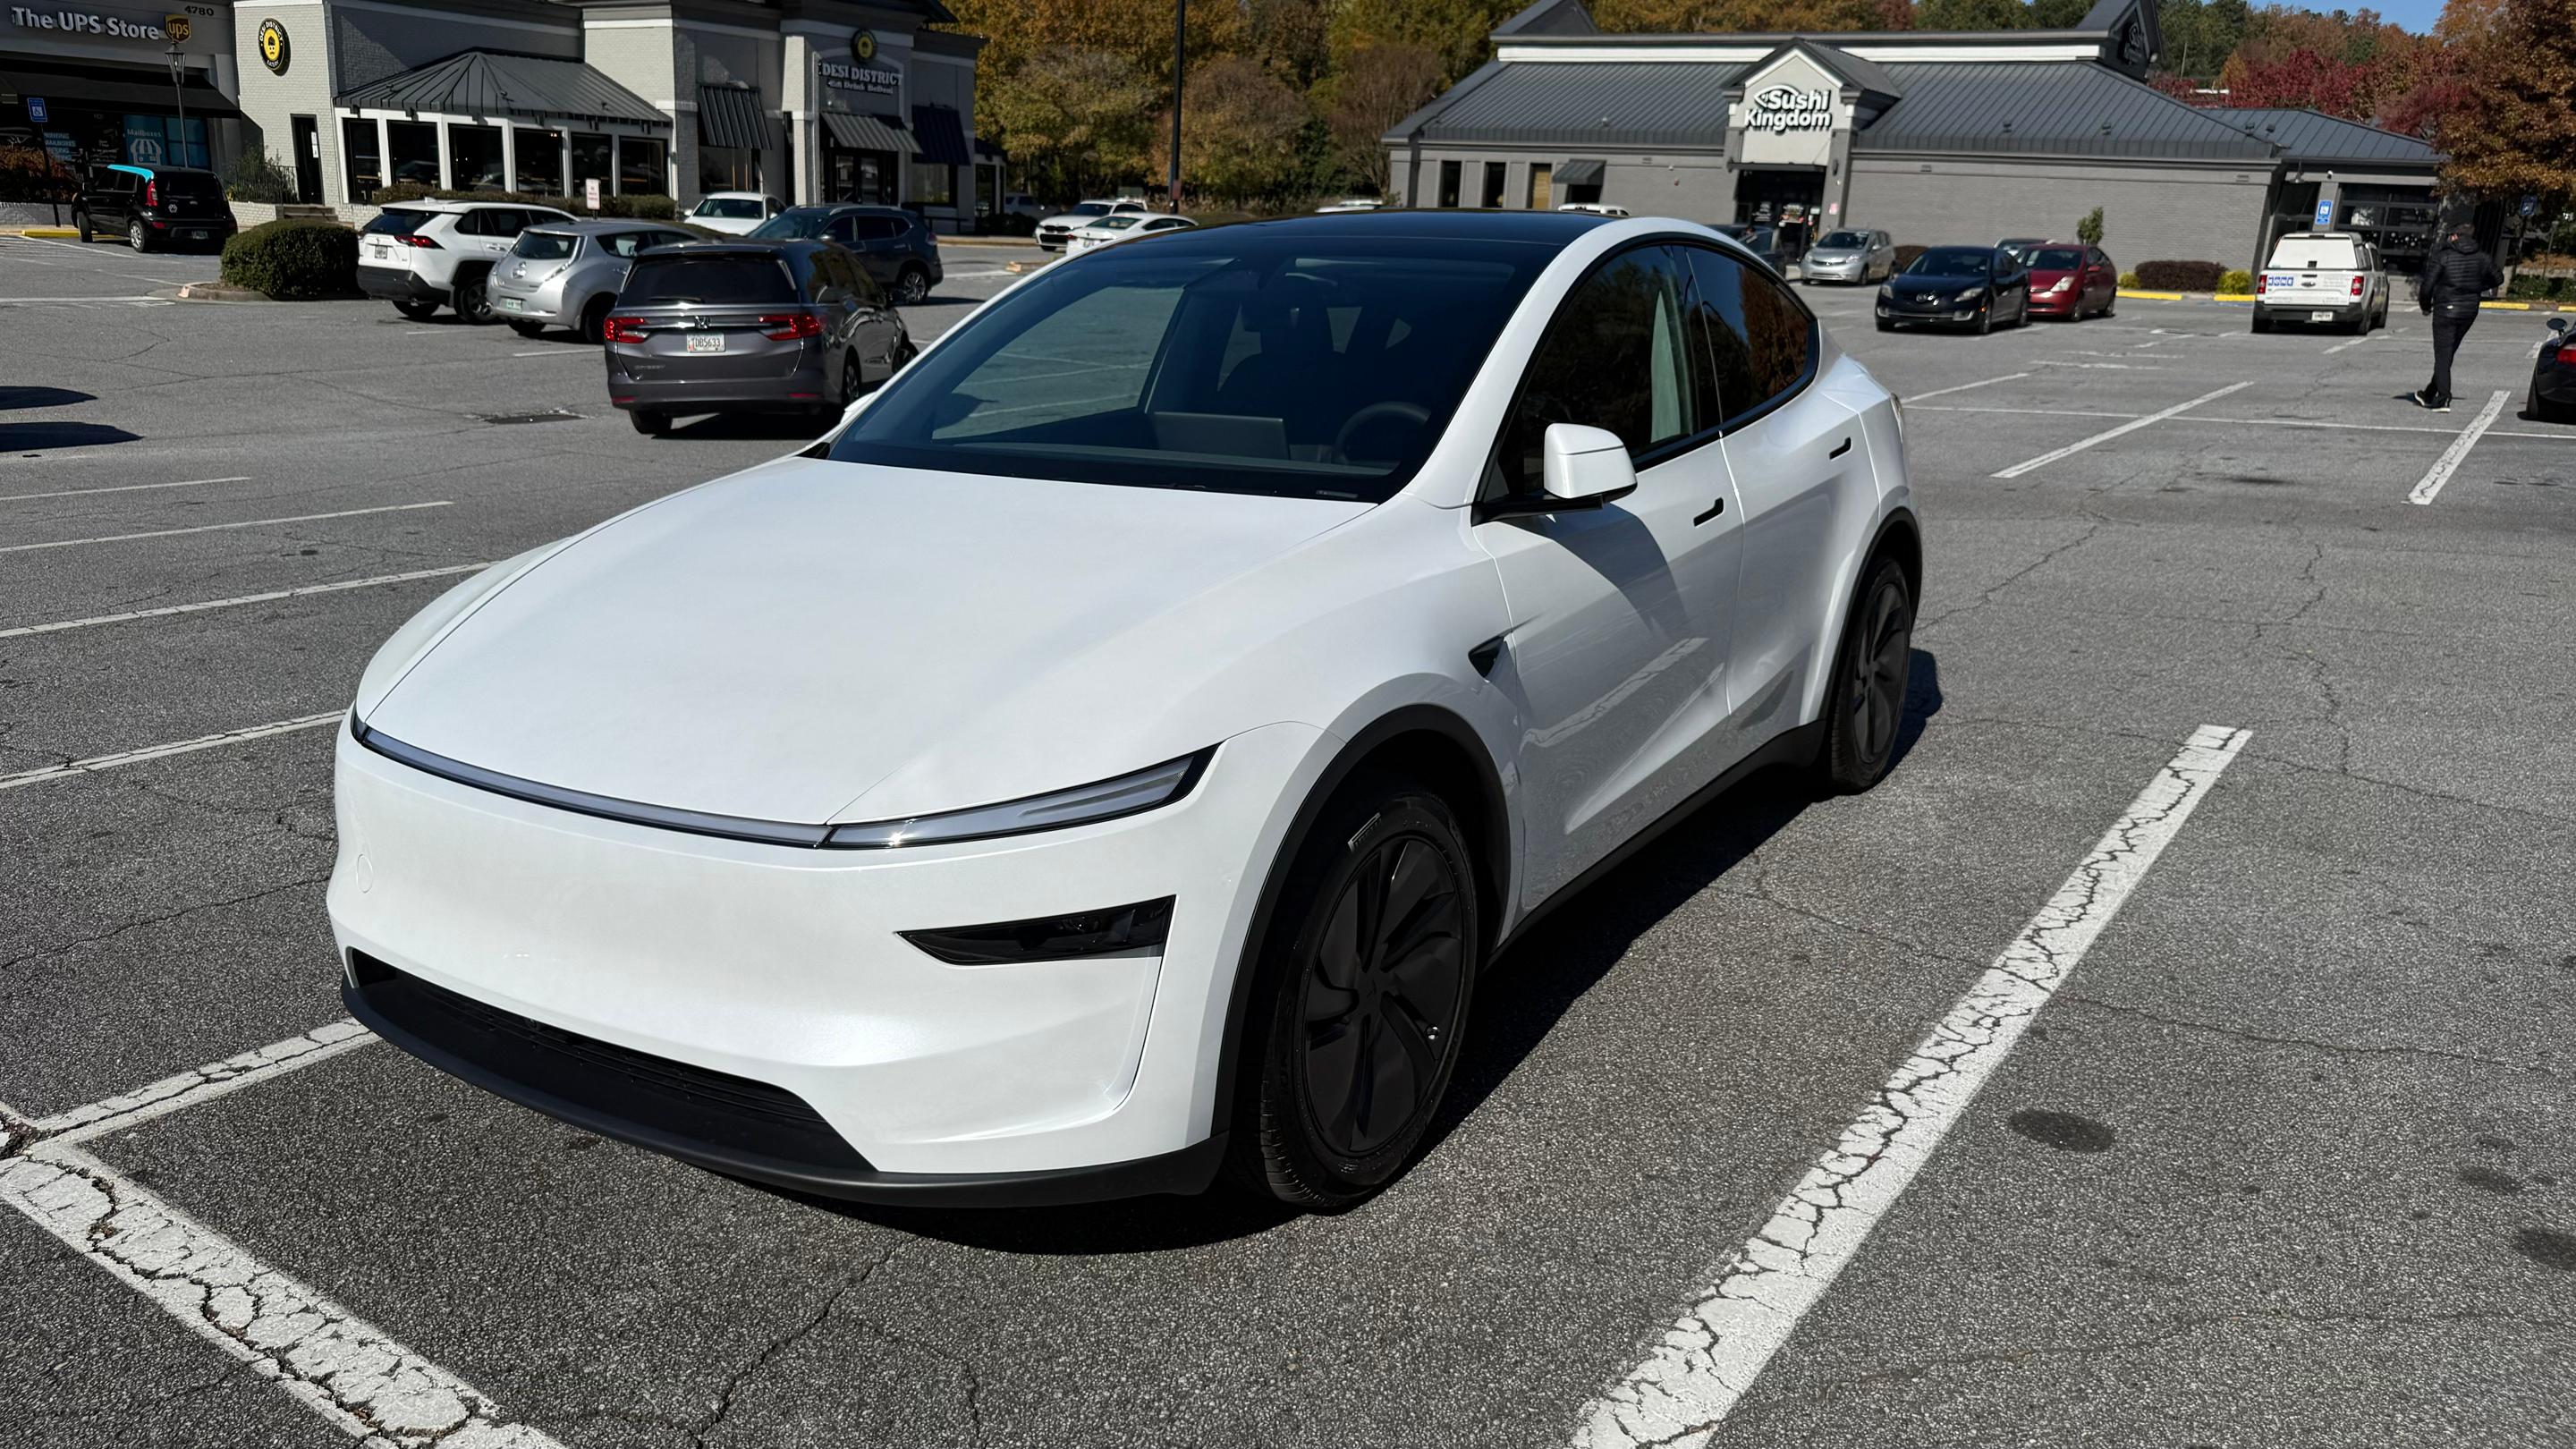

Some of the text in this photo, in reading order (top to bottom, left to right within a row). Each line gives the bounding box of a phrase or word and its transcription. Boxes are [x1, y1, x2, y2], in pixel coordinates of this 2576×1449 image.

[184, 5, 215, 16] 4780
[11, 6, 159, 40] The UPS Store
[168, 22, 189, 38] ups
[821, 63, 903, 86] DESI DISTRICT
[1767, 89, 1830, 110] Sushi
[1744, 107, 1832, 131] Kingdom
